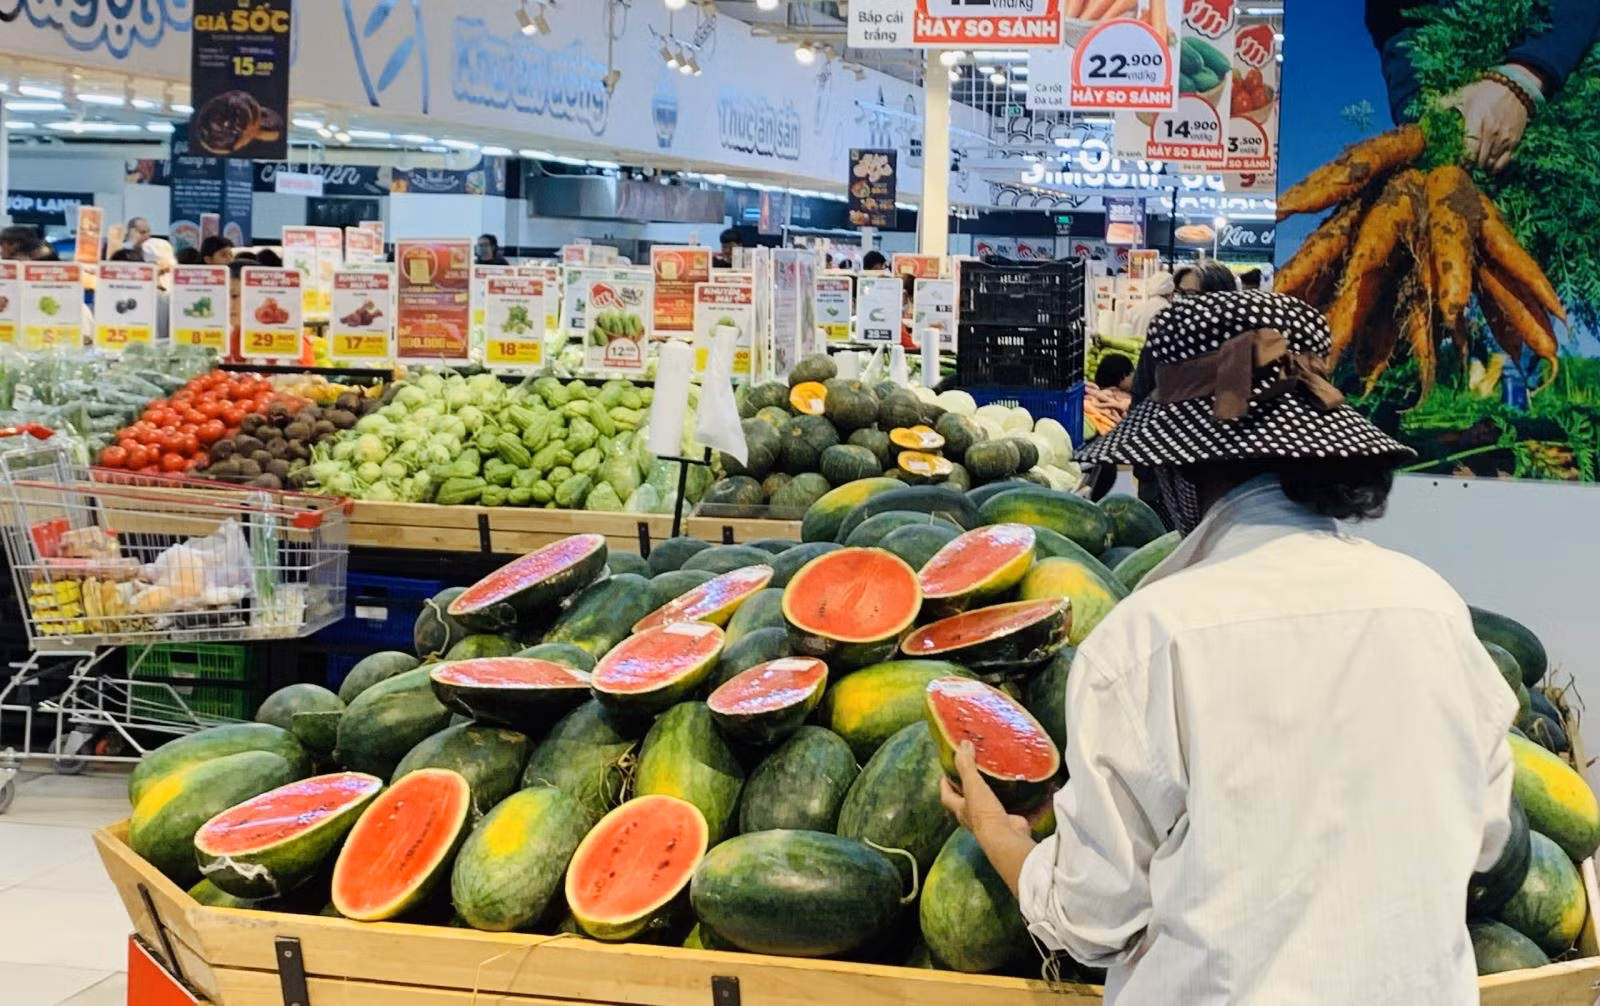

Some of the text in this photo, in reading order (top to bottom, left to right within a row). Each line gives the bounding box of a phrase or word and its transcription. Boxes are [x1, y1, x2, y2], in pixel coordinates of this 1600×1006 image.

[231, 3, 289, 33] SỐC
[965, 18, 994, 37] SO
[998, 15, 1057, 37] SÁNH
[1106, 90, 1127, 104] SO
[1129, 88, 1171, 104] SÁNH
[1164, 120, 1218, 138] 14.900
[1173, 146, 1189, 157] SO
[1191, 145, 1222, 159] SÁNH
[1228, 160, 1242, 169] SO
[498, 342, 516, 356] 18
